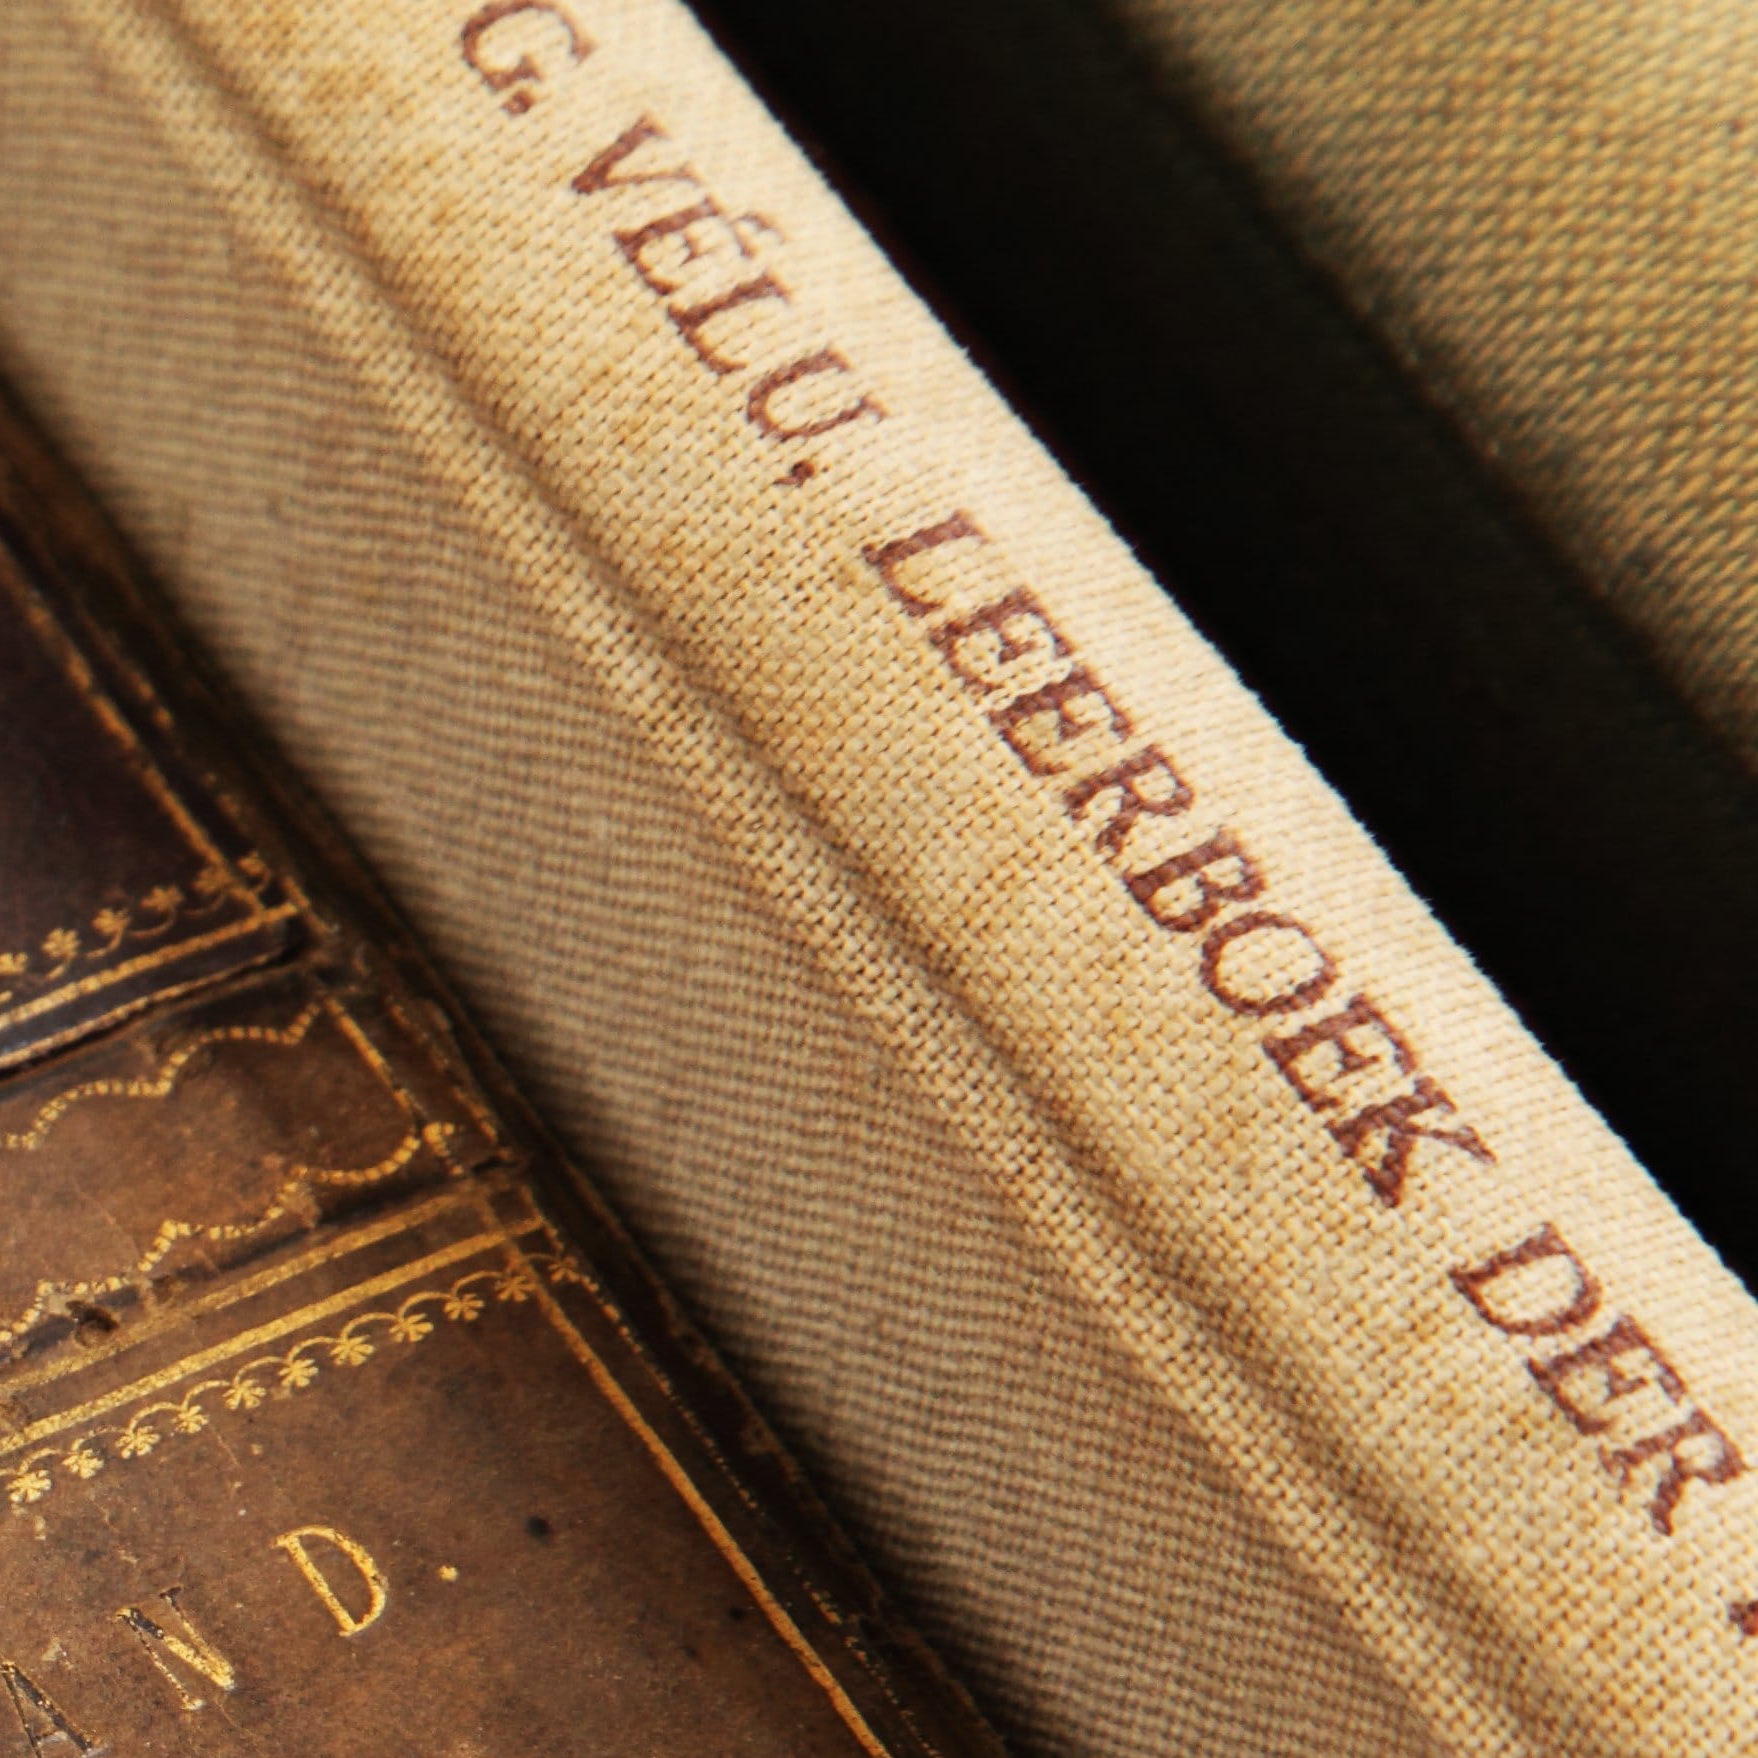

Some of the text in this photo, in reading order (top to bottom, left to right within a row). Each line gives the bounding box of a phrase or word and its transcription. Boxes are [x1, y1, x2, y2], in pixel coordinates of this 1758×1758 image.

[459, 0, 1751, 1536] G. VÉLU, LEERBOEK DER
